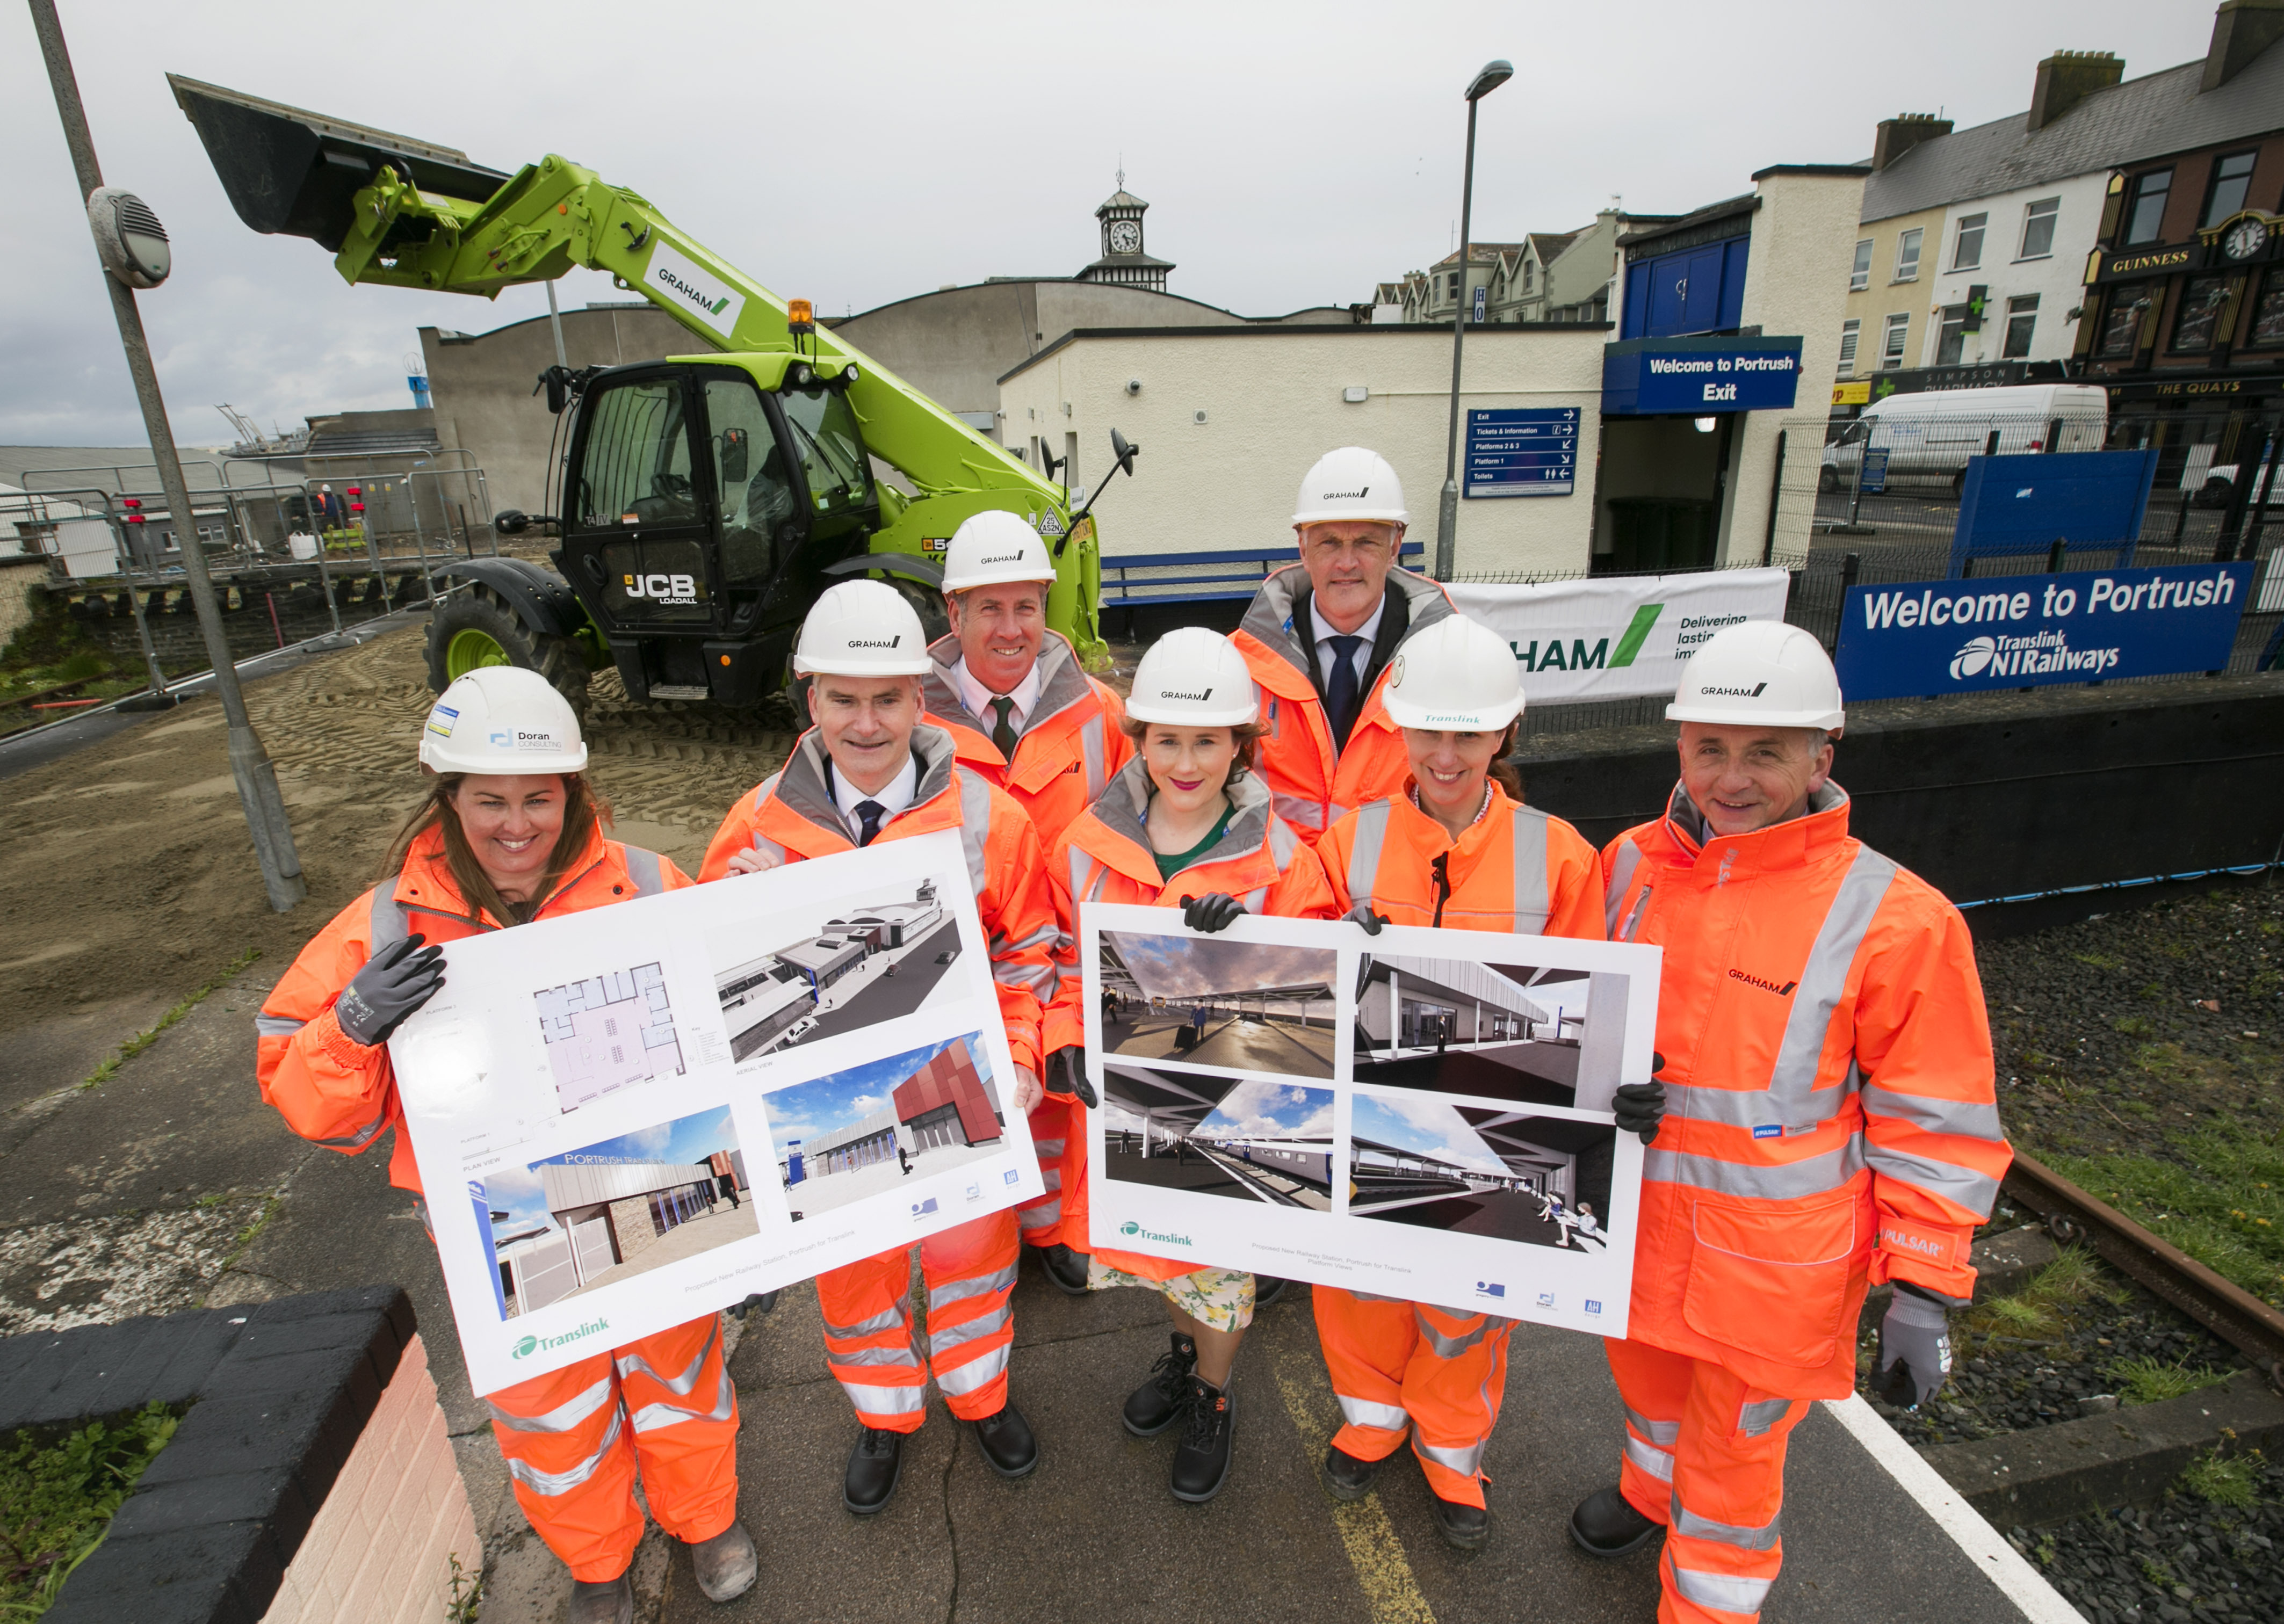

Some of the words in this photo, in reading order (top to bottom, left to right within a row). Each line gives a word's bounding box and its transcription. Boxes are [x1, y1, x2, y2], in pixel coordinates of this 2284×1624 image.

[2112, 250, 2189, 272] GUINNESS
[659, 268, 713, 311] GRAHAM
[1650, 359, 1713, 373] Welcome
[1717, 359, 1731, 371] to
[1735, 357, 1793, 371] Portrush
[1926, 369, 2006, 382] SIMPSON
[1703, 383, 1737, 401] Exit
[2157, 384, 2181, 395] THE
[2187, 381, 2240, 394] QUAYS
[934, 539, 949, 550] 5
[981, 555, 1016, 564] GRAHAM
[626, 575, 696, 597] JCB
[1864, 591, 2030, 630] Welcome
[2043, 584, 2076, 618] to
[2087, 570, 2235, 614] Portrush
[1678, 630, 1714, 644] lastin
[1997, 629, 2065, 651] Translink
[1509, 638, 1609, 672] HAM
[1161, 691, 1201, 700] GRAHAM
[1701, 687, 1751, 697] GRAHAM
[1426, 715, 1481, 723] Translink
[1729, 969, 1781, 994] GRAHAM
[736, 1065, 757, 1076] AERIAL
[758, 1061, 773, 1069] VIEW
[463, 1163, 482, 1172] PLAN
[483, 1157, 501, 1166] VIEW
[565, 1154, 623, 1165] PORTRUSH
[624, 1156, 644, 1165] TRAIN
[1006, 1170, 1017, 1184] AH
[1140, 1229, 1192, 1246] Translink
[1884, 1228, 1939, 1257] PULSAR
[685, 1277, 718, 1293] Proposed
[719, 1272, 734, 1281] New
[735, 1263, 762, 1277] Railway
[763, 1255, 788, 1266] Station,
[789, 1243, 816, 1257] Portrush
[828, 1230, 856, 1243] Translink
[1252, 1242, 1280, 1252] Proposed
[1296, 1250, 1320, 1259] Railway
[1321, 1254, 1345, 1263] Station,
[1346, 1258, 1372, 1267] Portrush
[1384, 1264, 1412, 1273] Translink
[1307, 1258, 1333, 1268] Platform
[1334, 1262, 1353, 1271] Views
[1587, 1301, 1600, 1313] AH
[538, 1317, 610, 1351] Translink
